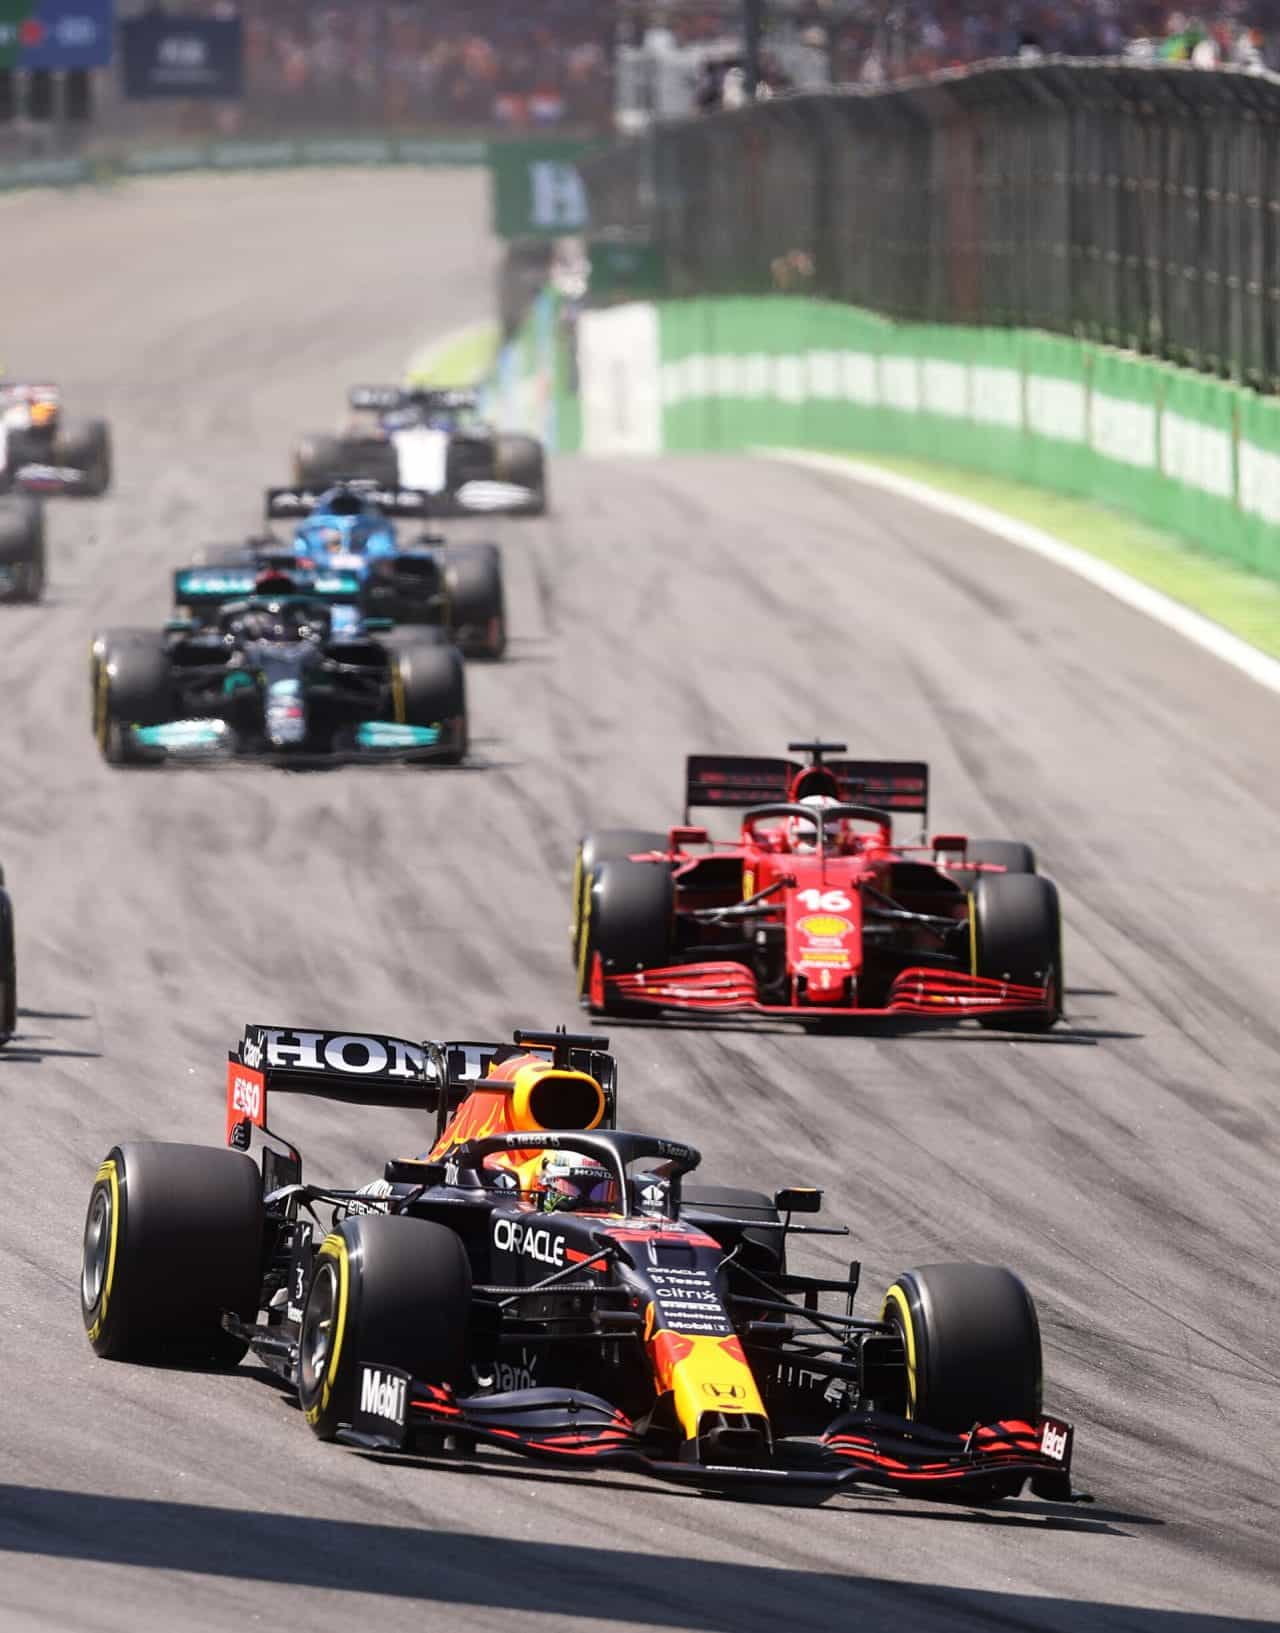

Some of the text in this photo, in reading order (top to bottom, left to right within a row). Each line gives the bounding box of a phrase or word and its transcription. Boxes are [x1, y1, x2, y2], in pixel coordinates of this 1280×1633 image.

[796, 888, 852, 912] 16
[494, 1219, 566, 1267] ORACLE
[656, 1287, 718, 1303] citrix
[361, 1368, 398, 1421] Mobil
